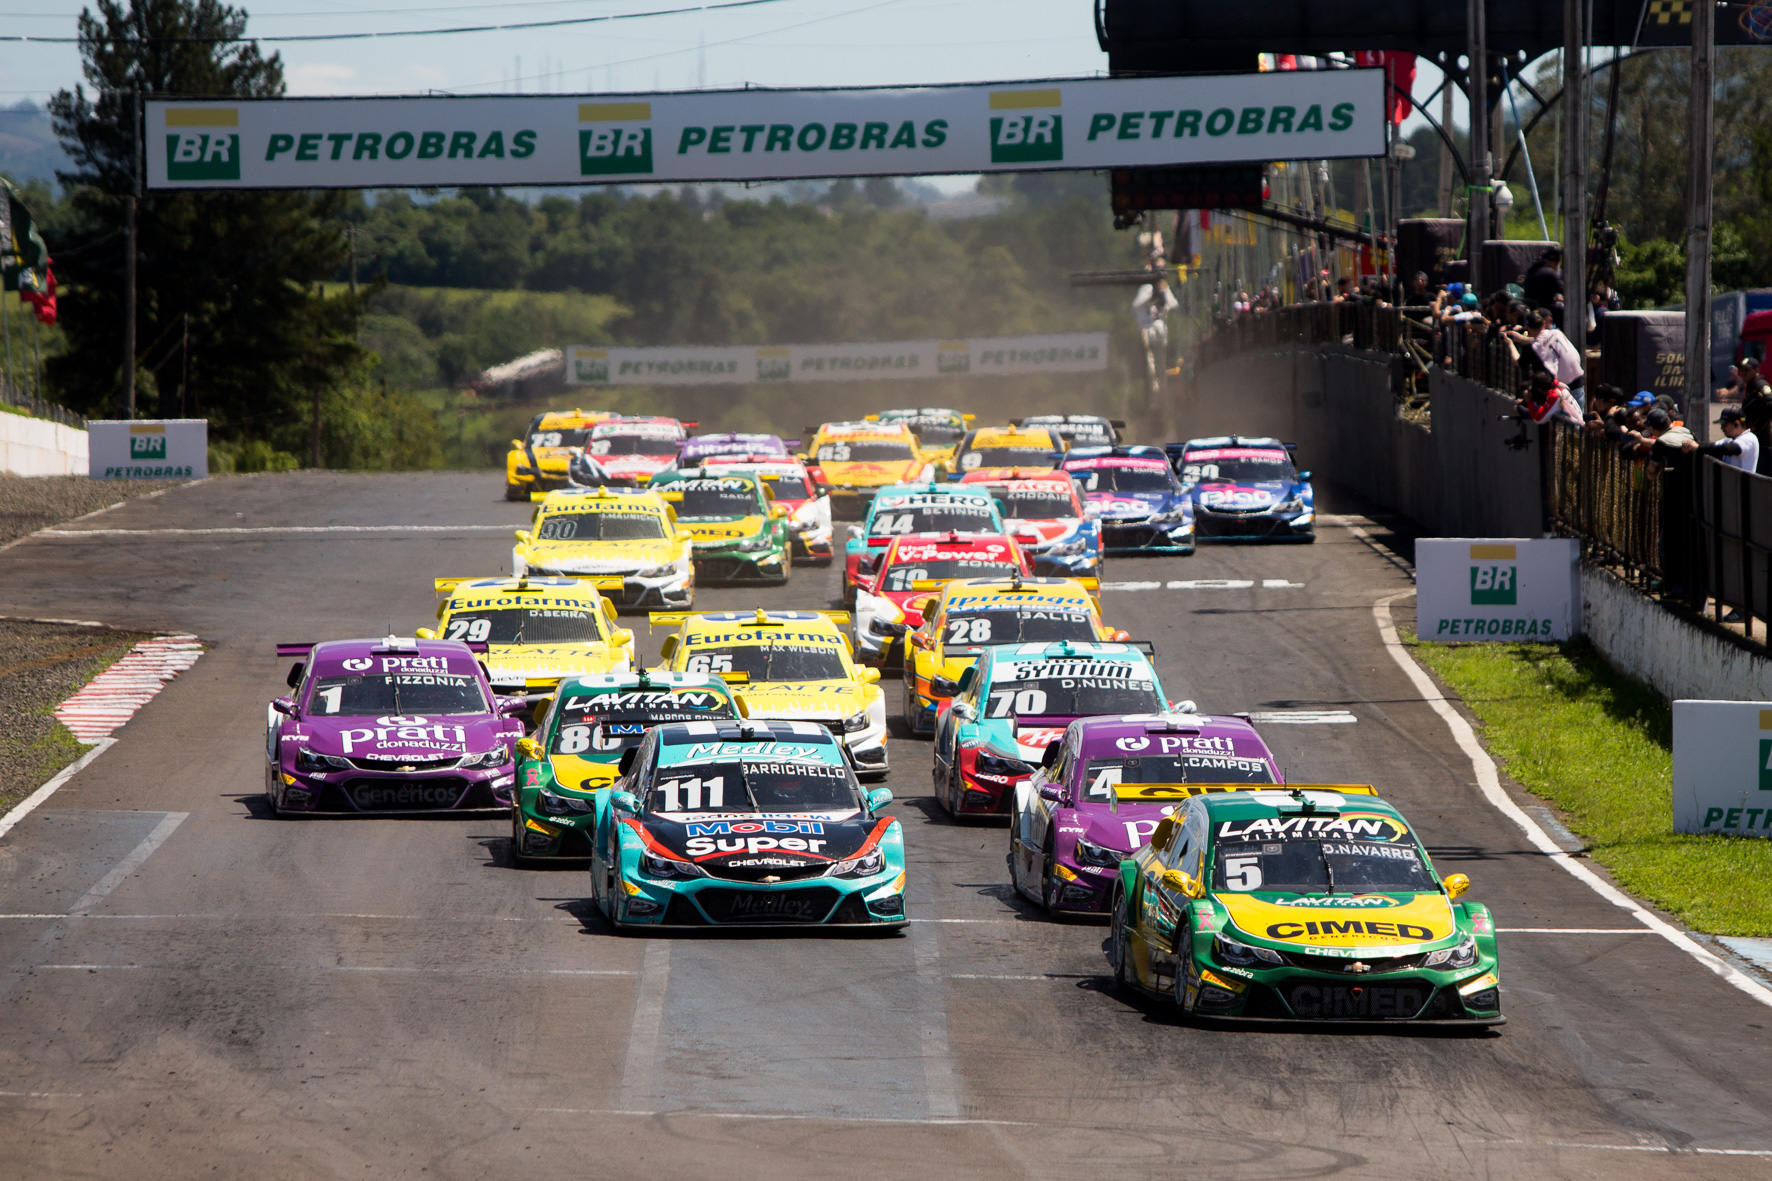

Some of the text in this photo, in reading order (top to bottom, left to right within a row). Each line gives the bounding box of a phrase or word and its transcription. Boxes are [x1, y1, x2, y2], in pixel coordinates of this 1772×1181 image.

[997, 115, 1056, 145] BR
[1087, 102, 1356, 141] PETROBRAS
[585, 128, 643, 158] BR
[678, 119, 949, 155] PETROBRAS
[172, 132, 230, 164] BR
[265, 131, 537, 161] PETROBRAS
[133, 436, 162, 451] BR
[105, 466, 193, 477] PETROBRAS
[908, 494, 988, 507] HERO
[1007, 491, 1070, 502] KHODAIR
[542, 503, 661, 515] Eurofarma
[923, 508, 990, 518] BETINHO
[540, 520, 577, 540] 90
[871, 513, 915, 535] 44
[898, 550, 999, 561] V-Power
[958, 560, 1016, 569] ZONTA
[1474, 566, 1512, 590] BR
[449, 596, 596, 610] Eurofarma
[948, 595, 1085, 607] Ipiranga
[530, 610, 587, 619] D.SERRA
[448, 619, 492, 642] 29
[949, 618, 992, 644] 28
[1437, 618, 1552, 635] PETROBRAS
[685, 630, 841, 646] Eurofarma
[788, 645, 835, 655] WILSON
[381, 656, 447, 673] prati
[687, 654, 733, 673] 65
[1015, 664, 1133, 680] SYNTIUM
[1062, 679, 1154, 691] D.NUNES
[319, 686, 342, 713] 1
[564, 692, 709, 711] LAVITAN
[583, 702, 681, 712] VITAMINAS
[989, 690, 1047, 719] 70
[339, 724, 467, 754] prati
[376, 740, 467, 752] donaduzzi
[558, 726, 622, 754] 80
[1159, 736, 1234, 753] prati
[366, 752, 444, 761] CHEVROLET
[1182, 747, 1235, 757] donaduzzi
[742, 763, 846, 779] BARRICHELLO
[1174, 757, 1263, 772] J.CAMPOS
[1089, 768, 1122, 799] 4
[657, 776, 724, 812] 111
[686, 821, 825, 838] Mobil
[1219, 817, 1383, 838] LAVITAN
[1241, 831, 1355, 842] VITAMINAS
[686, 837, 827, 857] Super
[1322, 843, 1414, 860] D.NAVARRO
[728, 858, 807, 867] CHEVROLET
[1225, 857, 1262, 891] 5
[1275, 897, 1383, 906] LAVITAN
[1266, 920, 1434, 940] CIMED
[1230, 967, 1254, 979] zebra
[1291, 985, 1423, 1016] CIMED
